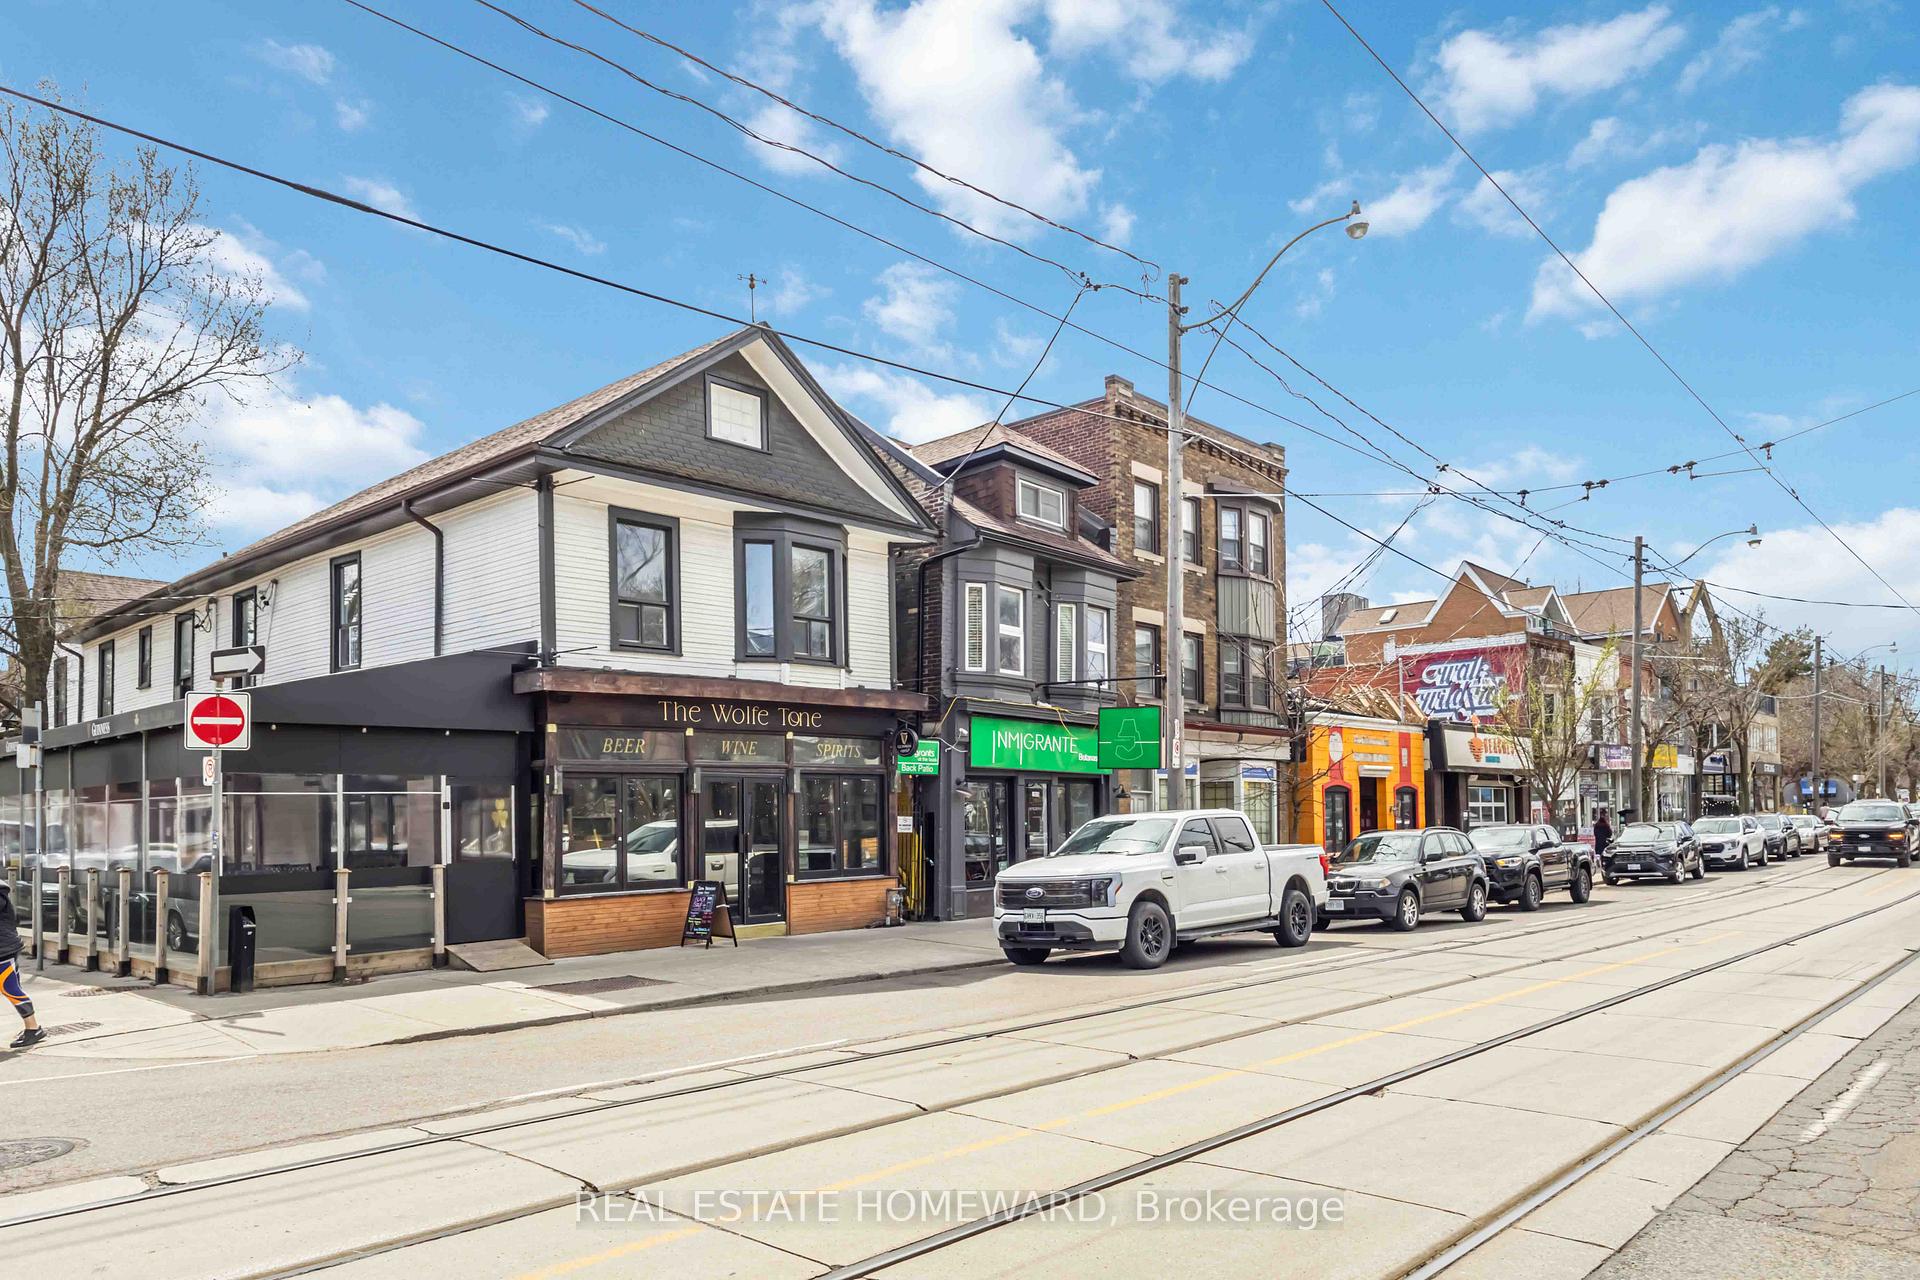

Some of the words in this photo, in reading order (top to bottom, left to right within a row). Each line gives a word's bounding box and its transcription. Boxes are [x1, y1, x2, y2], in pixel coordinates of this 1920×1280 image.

[658, 700, 701, 723] The
[711, 703, 769, 726] Wolfe
[778, 707, 822, 728] Tone
[602, 738, 646, 754] BEER
[722, 740, 757, 756] WINE
[816, 742, 861, 759] SPIRITS
[992, 730, 1079, 766] INMIGRANTE
[901, 763, 917, 772] Back
[918, 764, 934, 773] Patio
